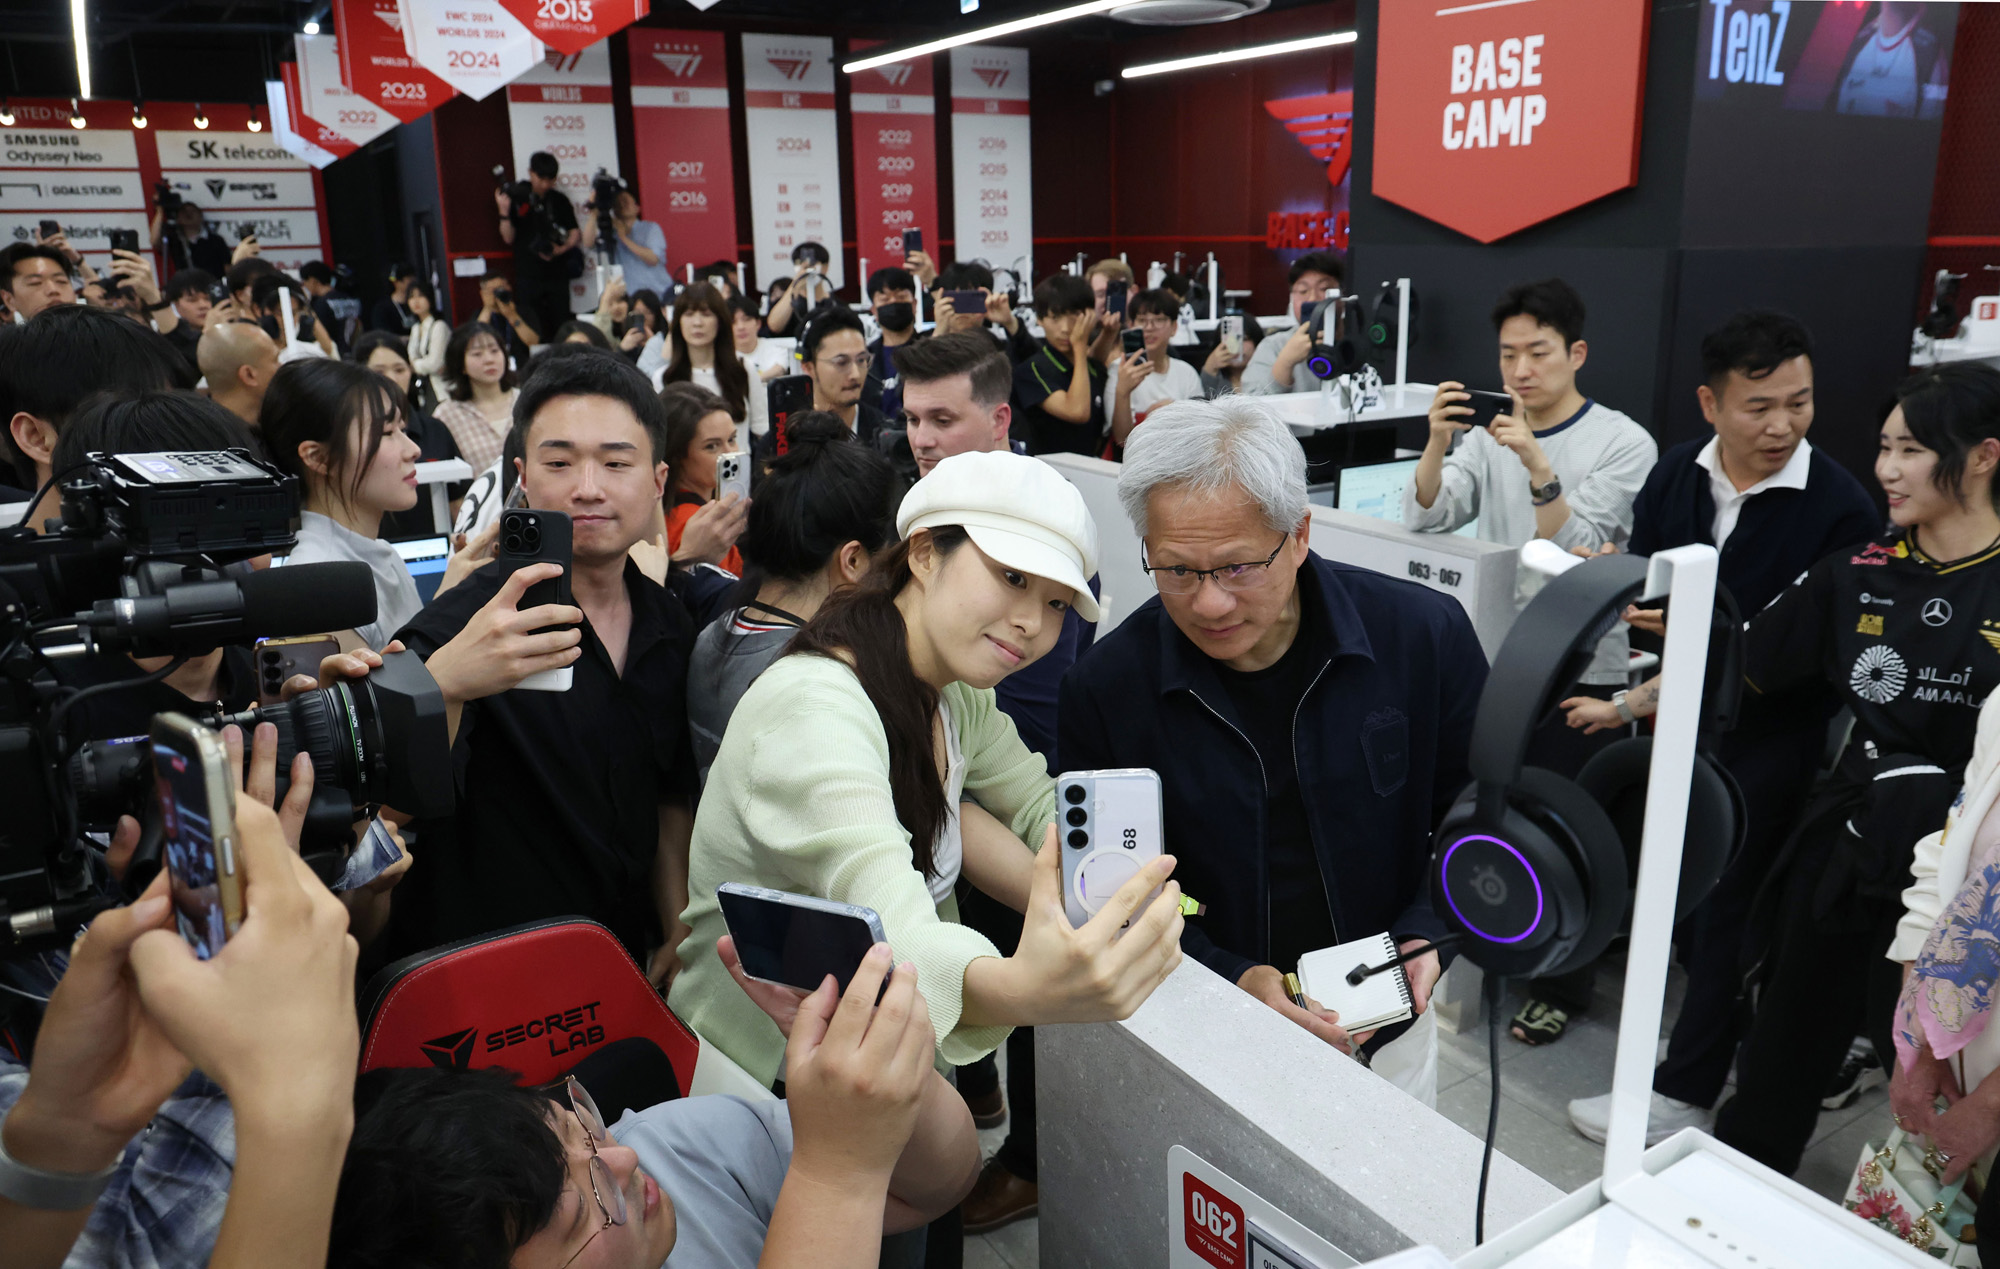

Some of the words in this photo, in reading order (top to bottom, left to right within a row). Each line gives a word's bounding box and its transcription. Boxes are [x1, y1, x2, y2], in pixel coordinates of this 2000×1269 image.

[537, 0, 594, 22] 2013
[1708, 0, 1791, 86] TenZ
[447, 50, 500, 68] 2024
[1451, 34, 1545, 94] BASE
[380, 81, 427, 99] 2023
[339, 110, 377, 123] 2022
[543, 115, 585, 130] 2025
[1442, 94, 1547, 150] CAMP
[5, 134, 80, 146] SAMSUNG
[777, 137, 811, 151] 2024
[878, 129, 912, 144] 2022
[7, 150, 70, 164] Odyssey
[73, 151, 103, 162] Neo
[188, 140, 219, 159] SK
[668, 162, 704, 177] 2017
[877, 156, 915, 171] 2020
[557, 173, 589, 188] 023
[881, 183, 913, 197] 2019
[670, 191, 707, 206] 2016
[882, 209, 914, 224] 2019
[1266, 211, 1330, 248] BASE
[884, 236, 904, 251] 20
[348, 705, 359, 728] FUJINON
[356, 739, 362, 747] TV
[357, 746, 365, 762] ZOOM
[485, 1001, 601, 1053] SECRET
[549, 1025, 606, 1057] LAB
[1192, 1191, 1237, 1249] 062
[1207, 1242, 1220, 1257] BASE
[1220, 1251, 1235, 1266] CAMP
